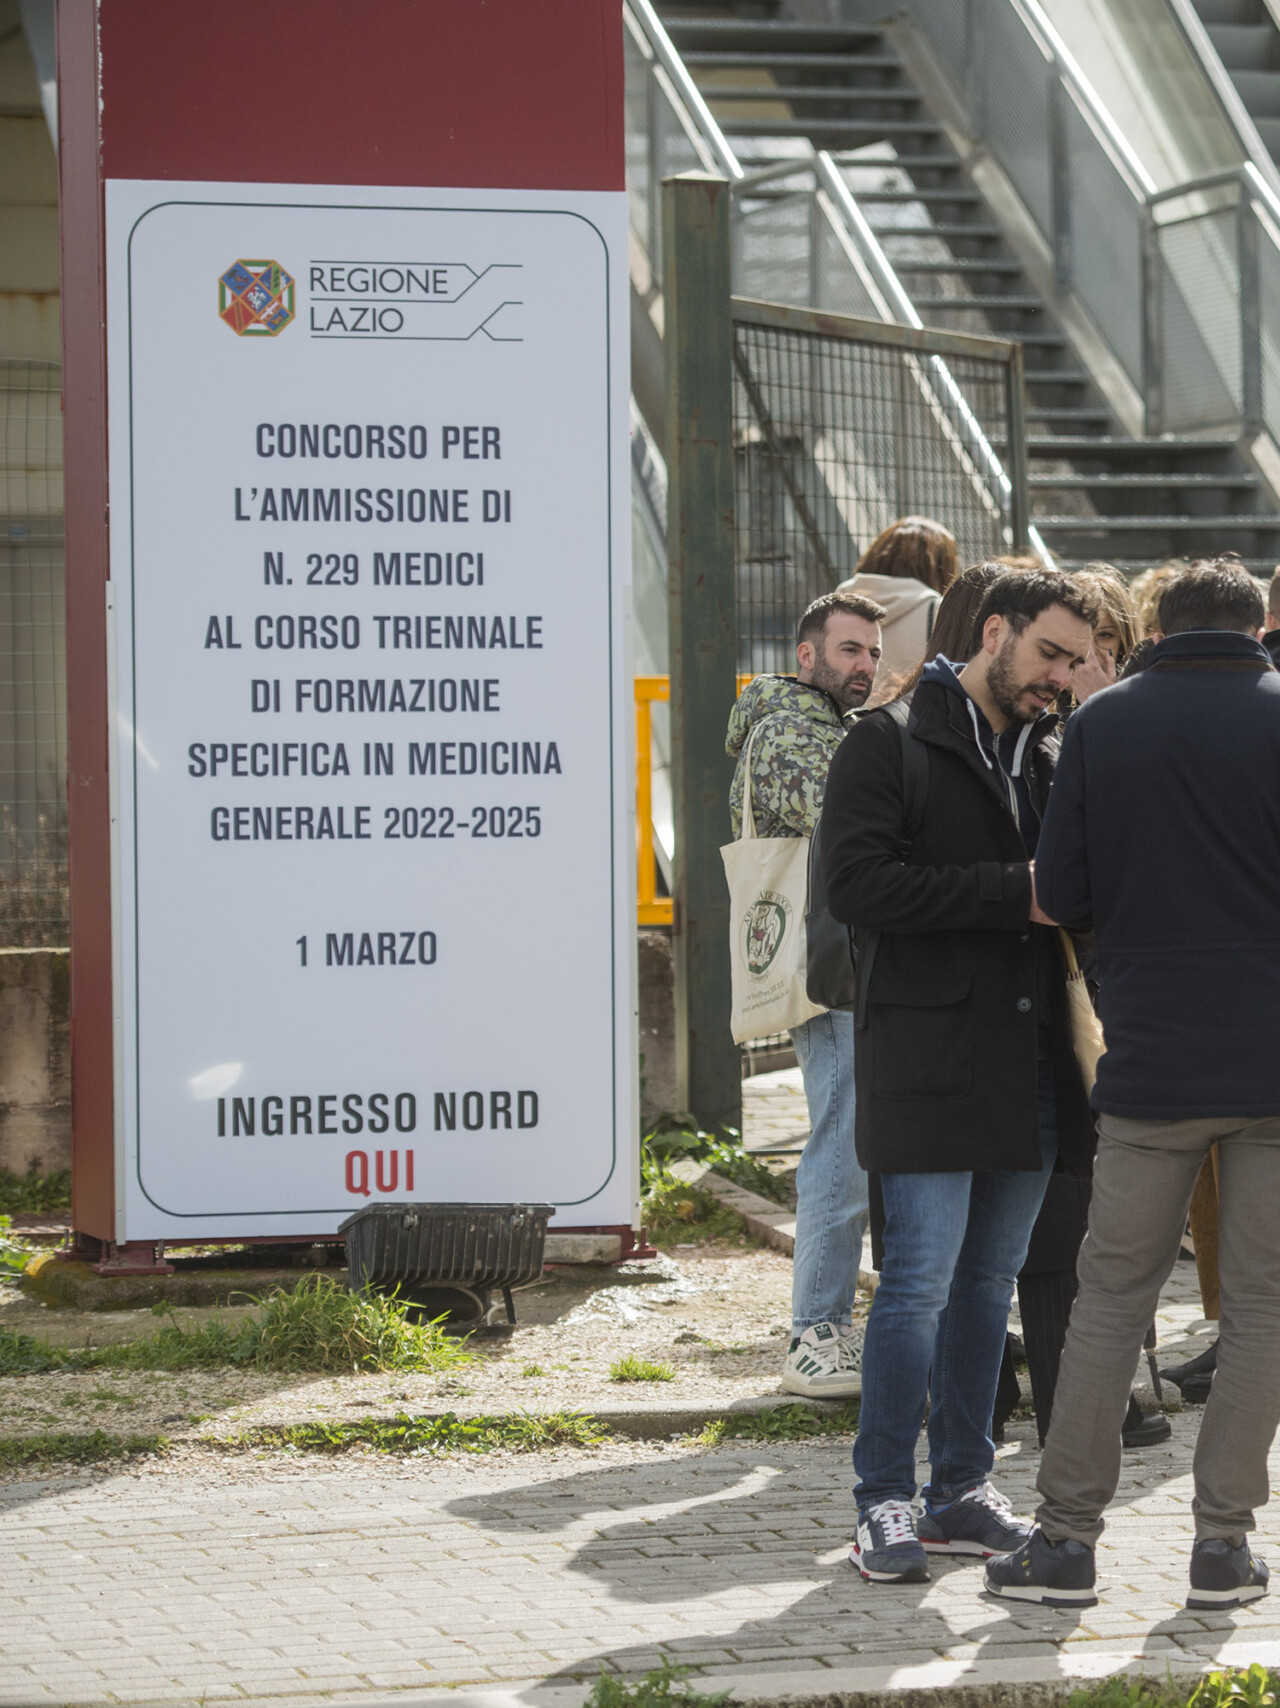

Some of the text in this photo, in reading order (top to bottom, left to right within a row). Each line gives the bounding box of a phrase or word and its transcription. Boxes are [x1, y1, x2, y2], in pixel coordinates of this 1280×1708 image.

[310, 267, 449, 295] REGIONE
[310, 307, 404, 333] LAZIO
[256, 423, 501, 460] CONCORSO PER
[234, 487, 511, 523] L’AMMISSIONE DI
[263, 552, 484, 586] N. 229 MEDICI
[204, 615, 543, 650] AL CORSO TRIENNALE
[251, 679, 500, 713] DI FORMAZIONE
[188, 742, 562, 777] SPECIFICA IN MEDICINA
[211, 806, 541, 841] GENERALE 2022-2025
[296, 931, 437, 967] 1 MARZO
[217, 1090, 539, 1137] INGRESSO NORD
[345, 1149, 414, 1197] QUI
